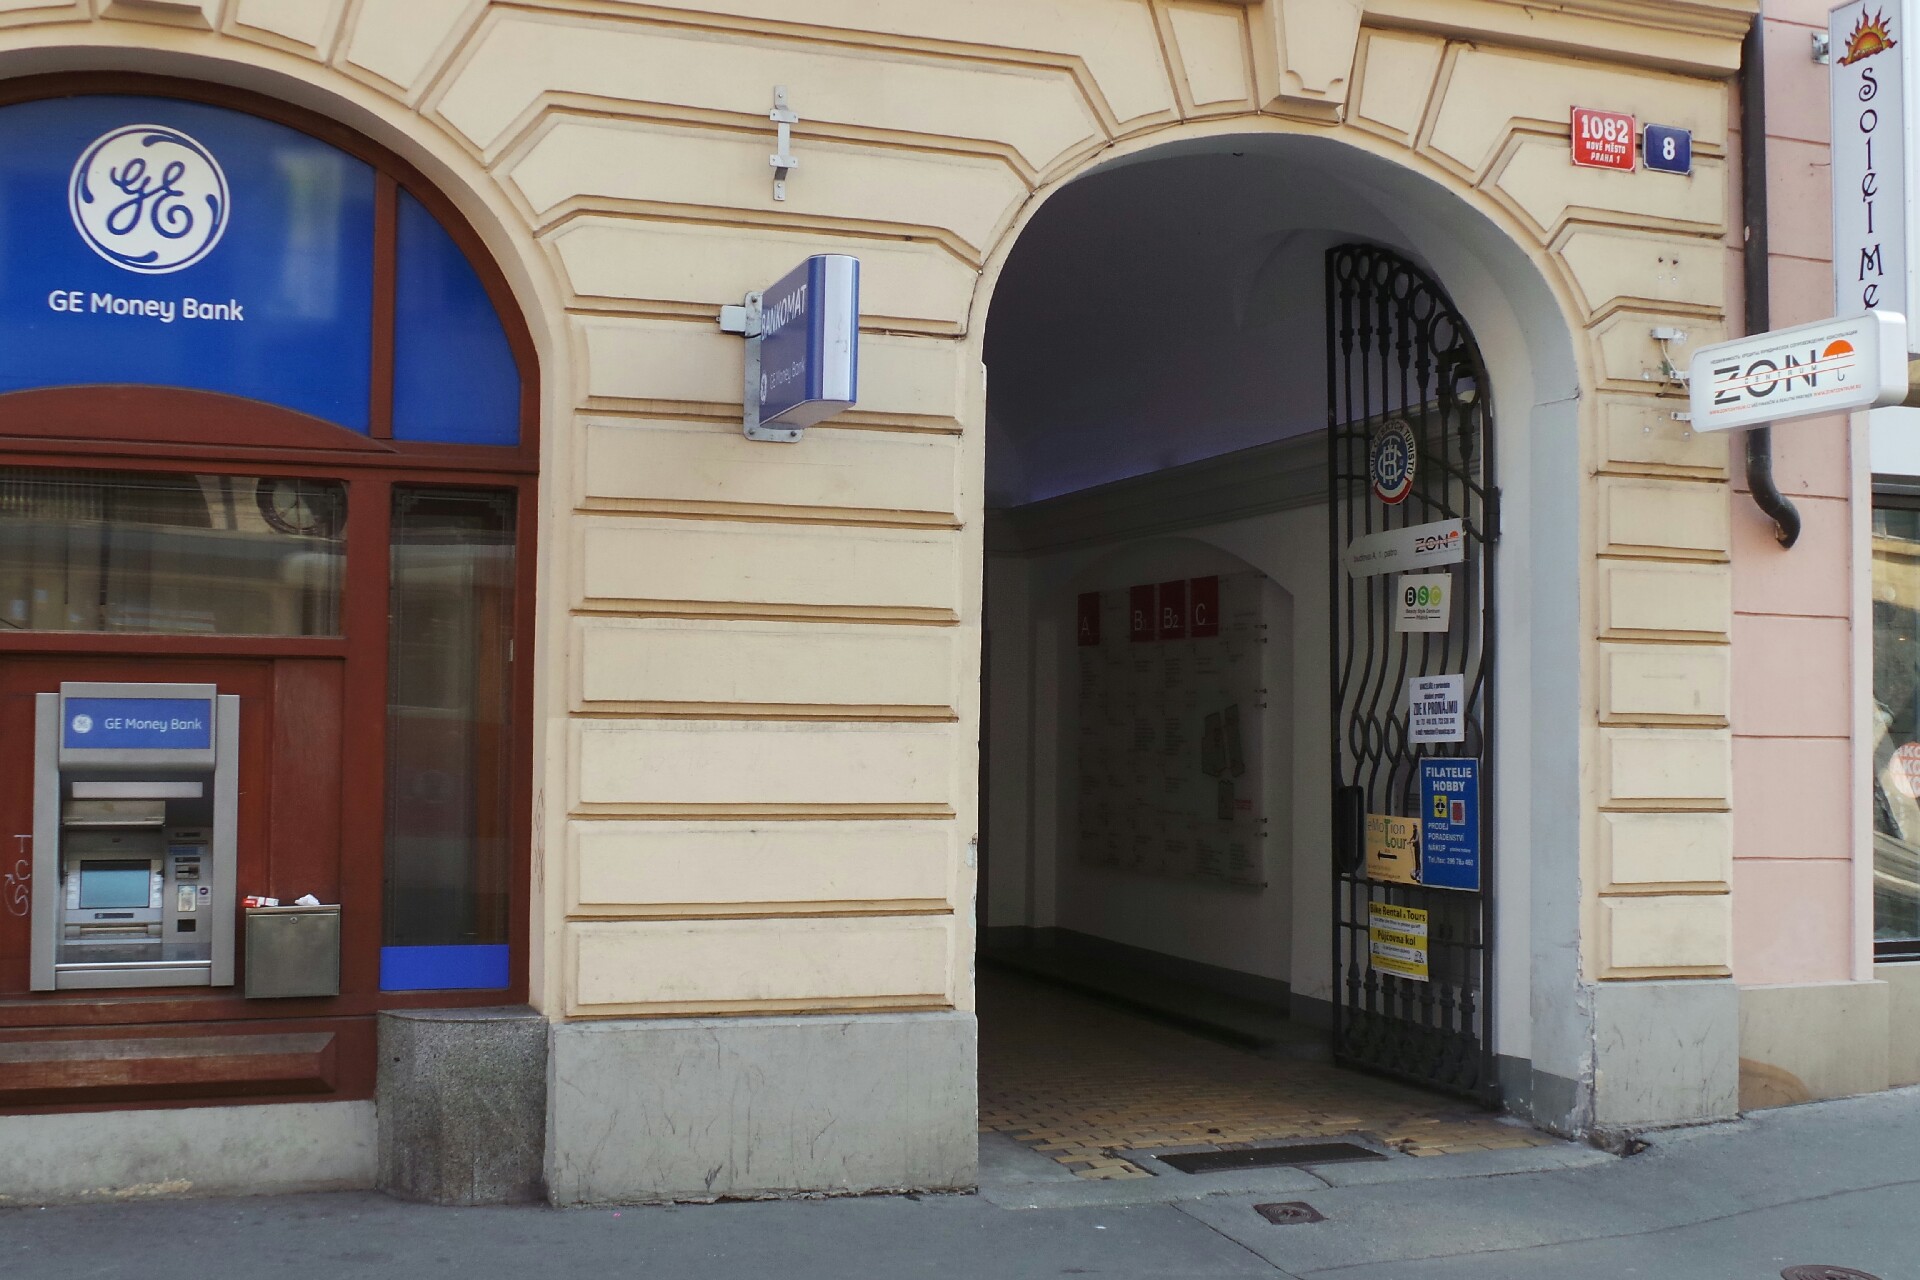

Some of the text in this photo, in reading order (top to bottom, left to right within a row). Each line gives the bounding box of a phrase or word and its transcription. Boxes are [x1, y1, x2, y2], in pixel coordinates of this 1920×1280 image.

[1581, 114, 1629, 144] 1082
[1586, 141, 1626, 155] NOVÉ MĚSTO
[1662, 137, 1676, 161] 8
[1590, 153, 1621, 164] PRAHA 1
[48, 290, 244, 323] GE Money Bank
[761, 284, 807, 341] BANKOMAT
[1744, 365, 1817, 385] CENTRUM
[1404, 429, 1415, 475] TURISTŮ
[1163, 607, 1178, 629] B2
[1195, 603, 1207, 626] C
[1081, 615, 1090, 636] A
[104, 718, 122, 730] GE
[125, 718, 167, 732] Money
[171, 718, 202, 730] Bank
[1426, 767, 1472, 778] FILATELIE
[1432, 781, 1465, 792] HOBBY
[1427, 822, 1449, 831] PRODEJ
[1427, 832, 1465, 842] PORADENSTVÍ
[1427, 843, 1446, 852] NÁKUP
[1370, 903, 1382, 915] Bike
[1383, 906, 1402, 919] Rental
[1406, 909, 1426, 922] Tours
[1377, 930, 1416, 946] Půjčovna kol
